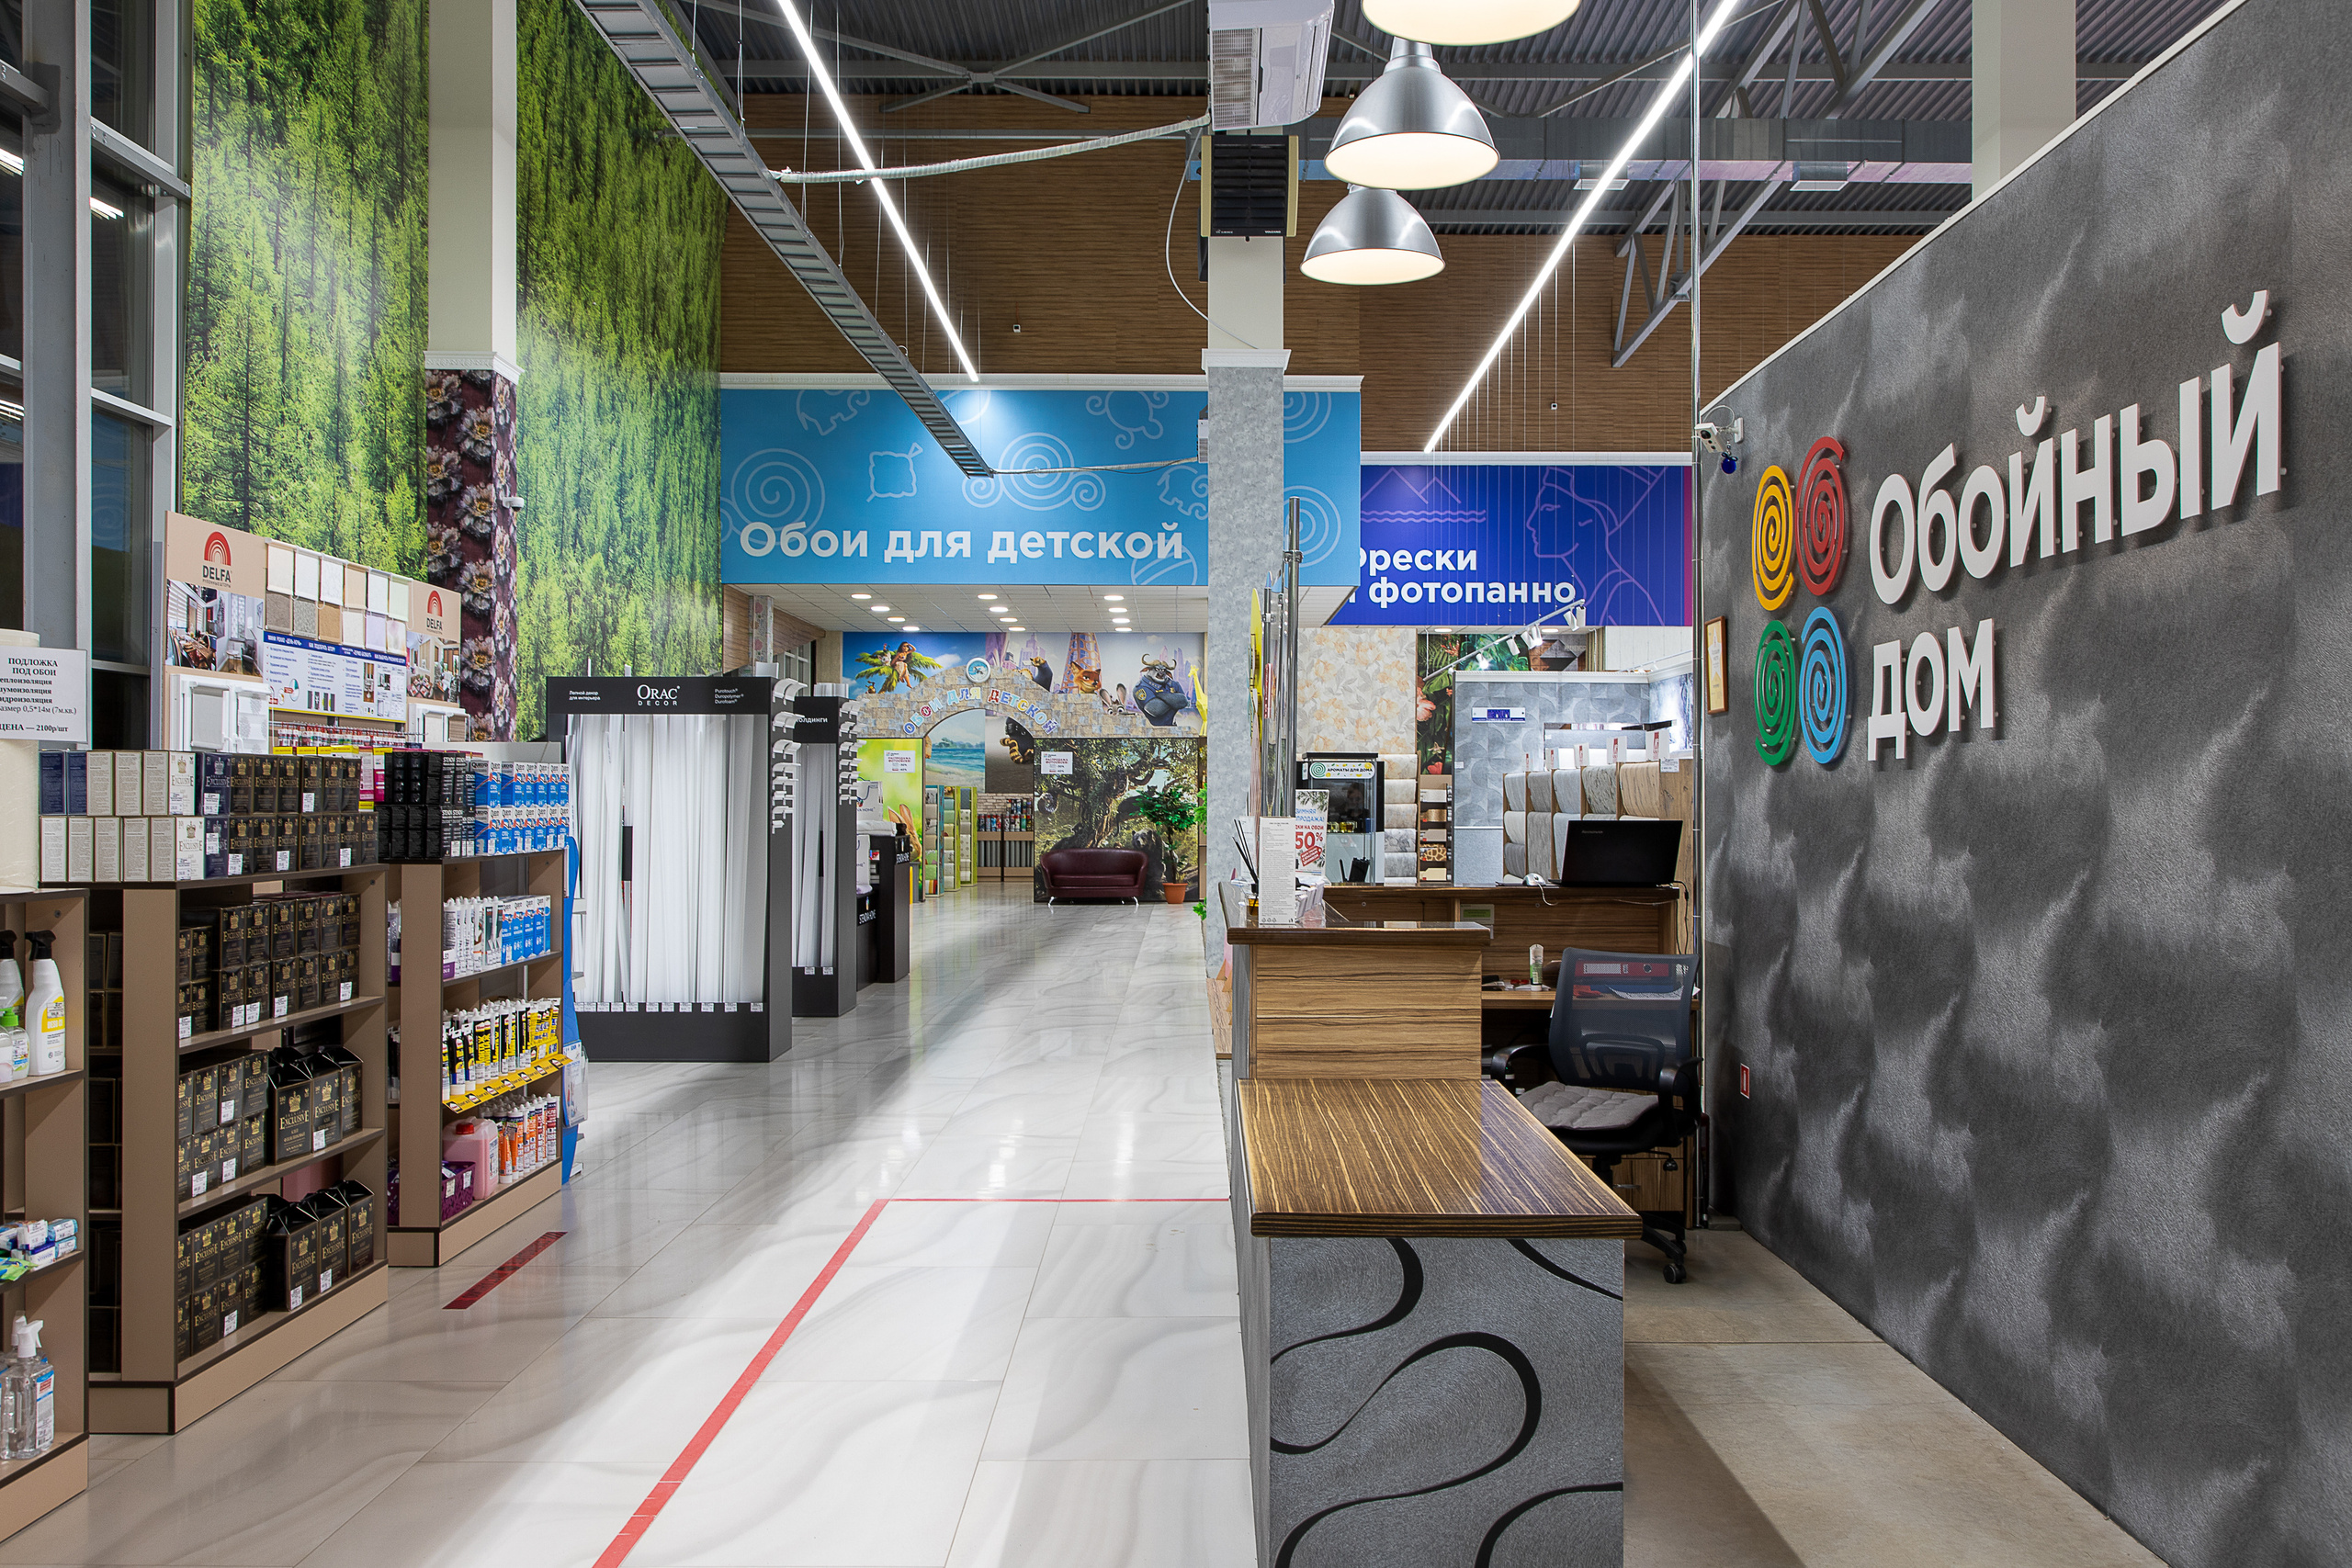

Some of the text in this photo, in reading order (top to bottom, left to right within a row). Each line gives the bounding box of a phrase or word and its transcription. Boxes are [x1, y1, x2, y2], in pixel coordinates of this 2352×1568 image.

[1869, 289, 2281, 604] Обойный
[740, 520, 1184, 564] Обои для детской
[202, 564, 232, 583] DELFA
[1368, 576, 1577, 609] фотопанно
[426, 617, 443, 631] DELFA
[8, 657, 58, 667] ПОДЛОЖКА
[12, 667, 31, 676] ПОД
[0, 696, 53, 705] идроизоляция
[51, 706, 77, 715] (7м.кв.)
[903, 687, 1058, 734] ОБОИ ДЛЯ ДЕТСКОЙ
[36, 724, 68, 733] 2100р/шт
[280, 1110, 309, 1130] EXCLUSIVE
